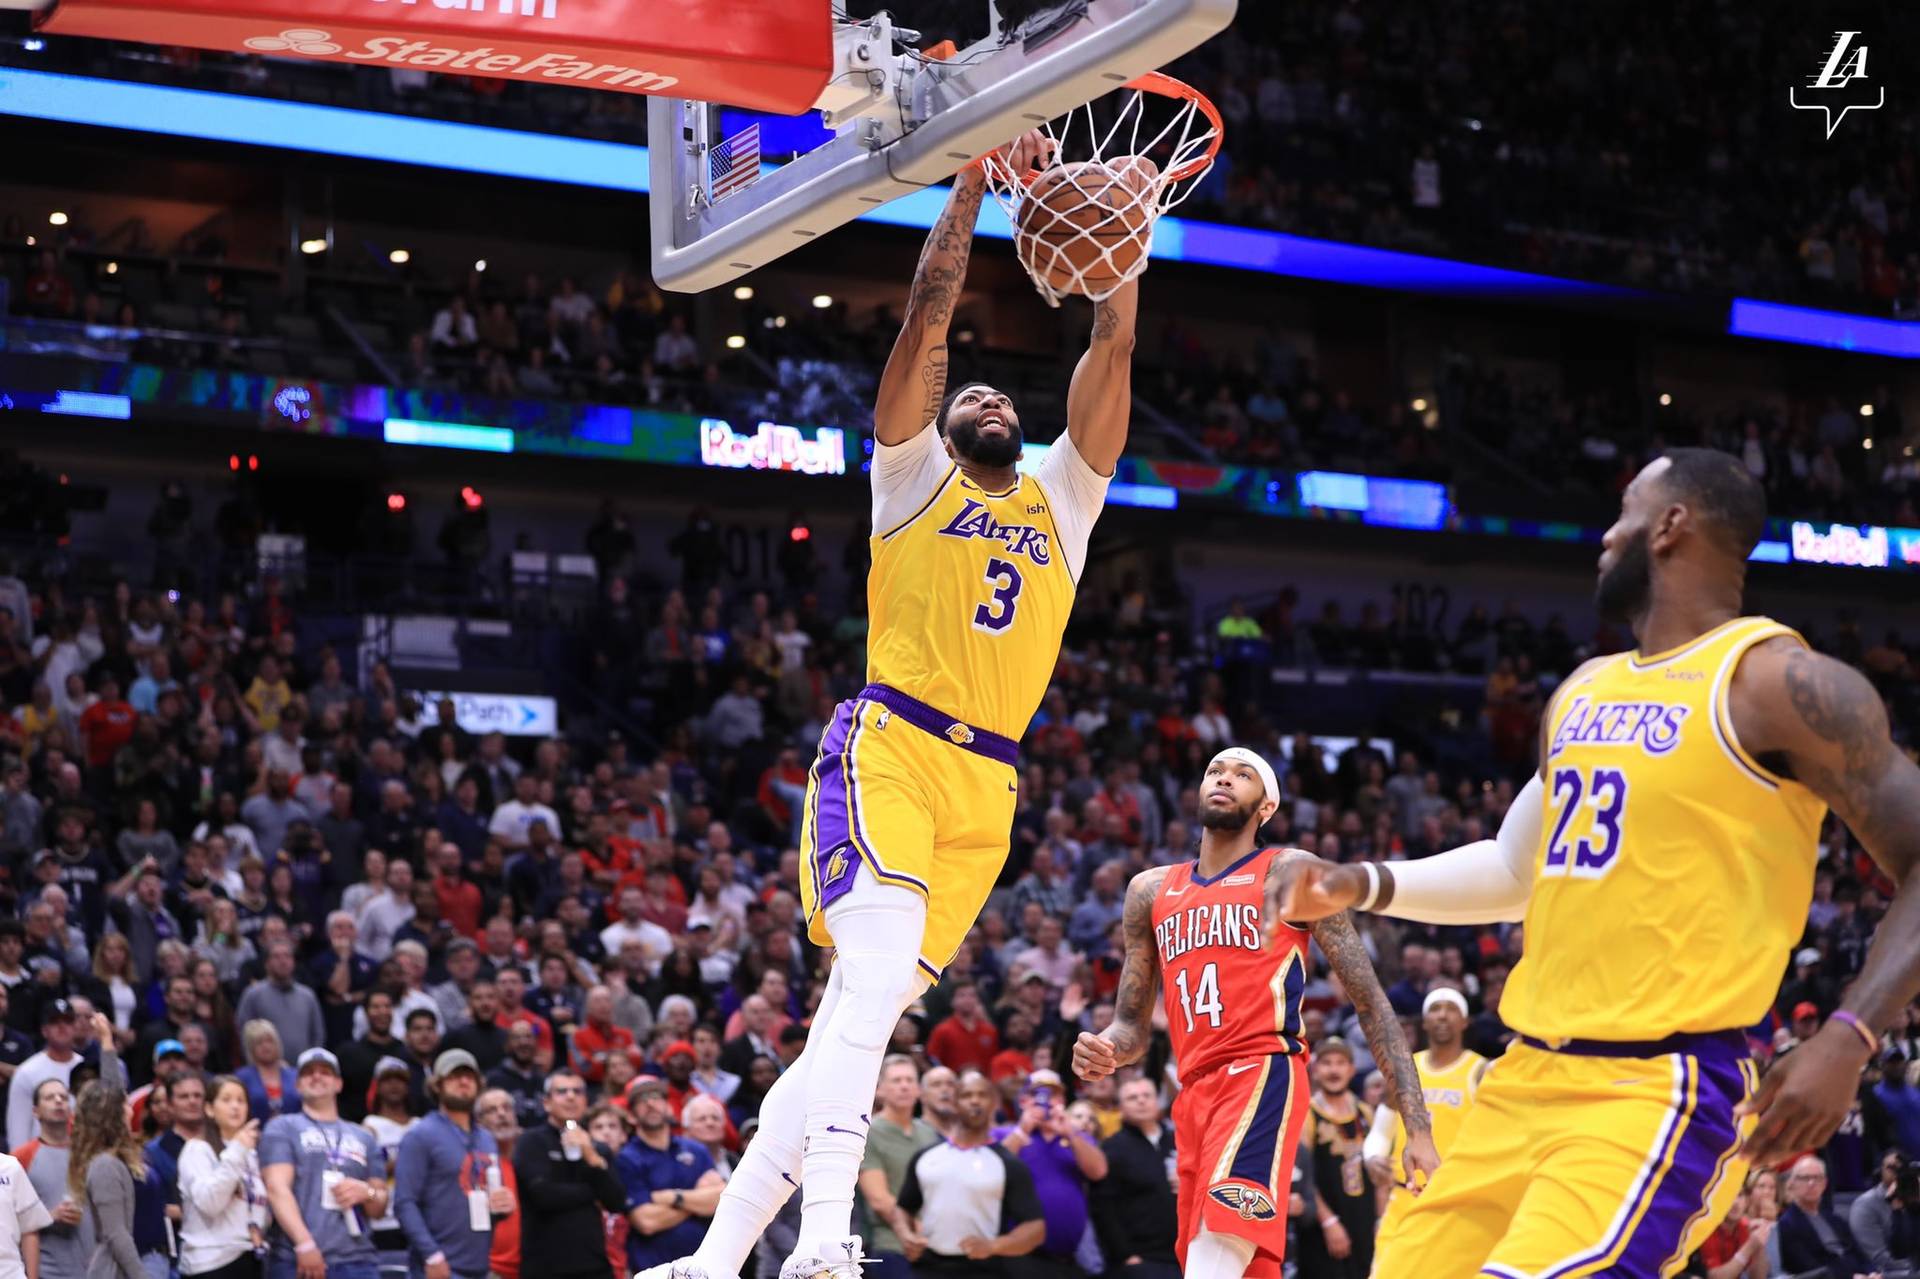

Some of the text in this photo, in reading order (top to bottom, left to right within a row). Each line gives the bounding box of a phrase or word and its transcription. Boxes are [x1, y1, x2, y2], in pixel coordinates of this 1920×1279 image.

[972, 556, 1024, 636] 3
[1547, 696, 1692, 757] LAKERS
[1541, 764, 1631, 878] 23
[1155, 903, 1261, 963] PELICANS
[1175, 962, 1224, 1033] 14
